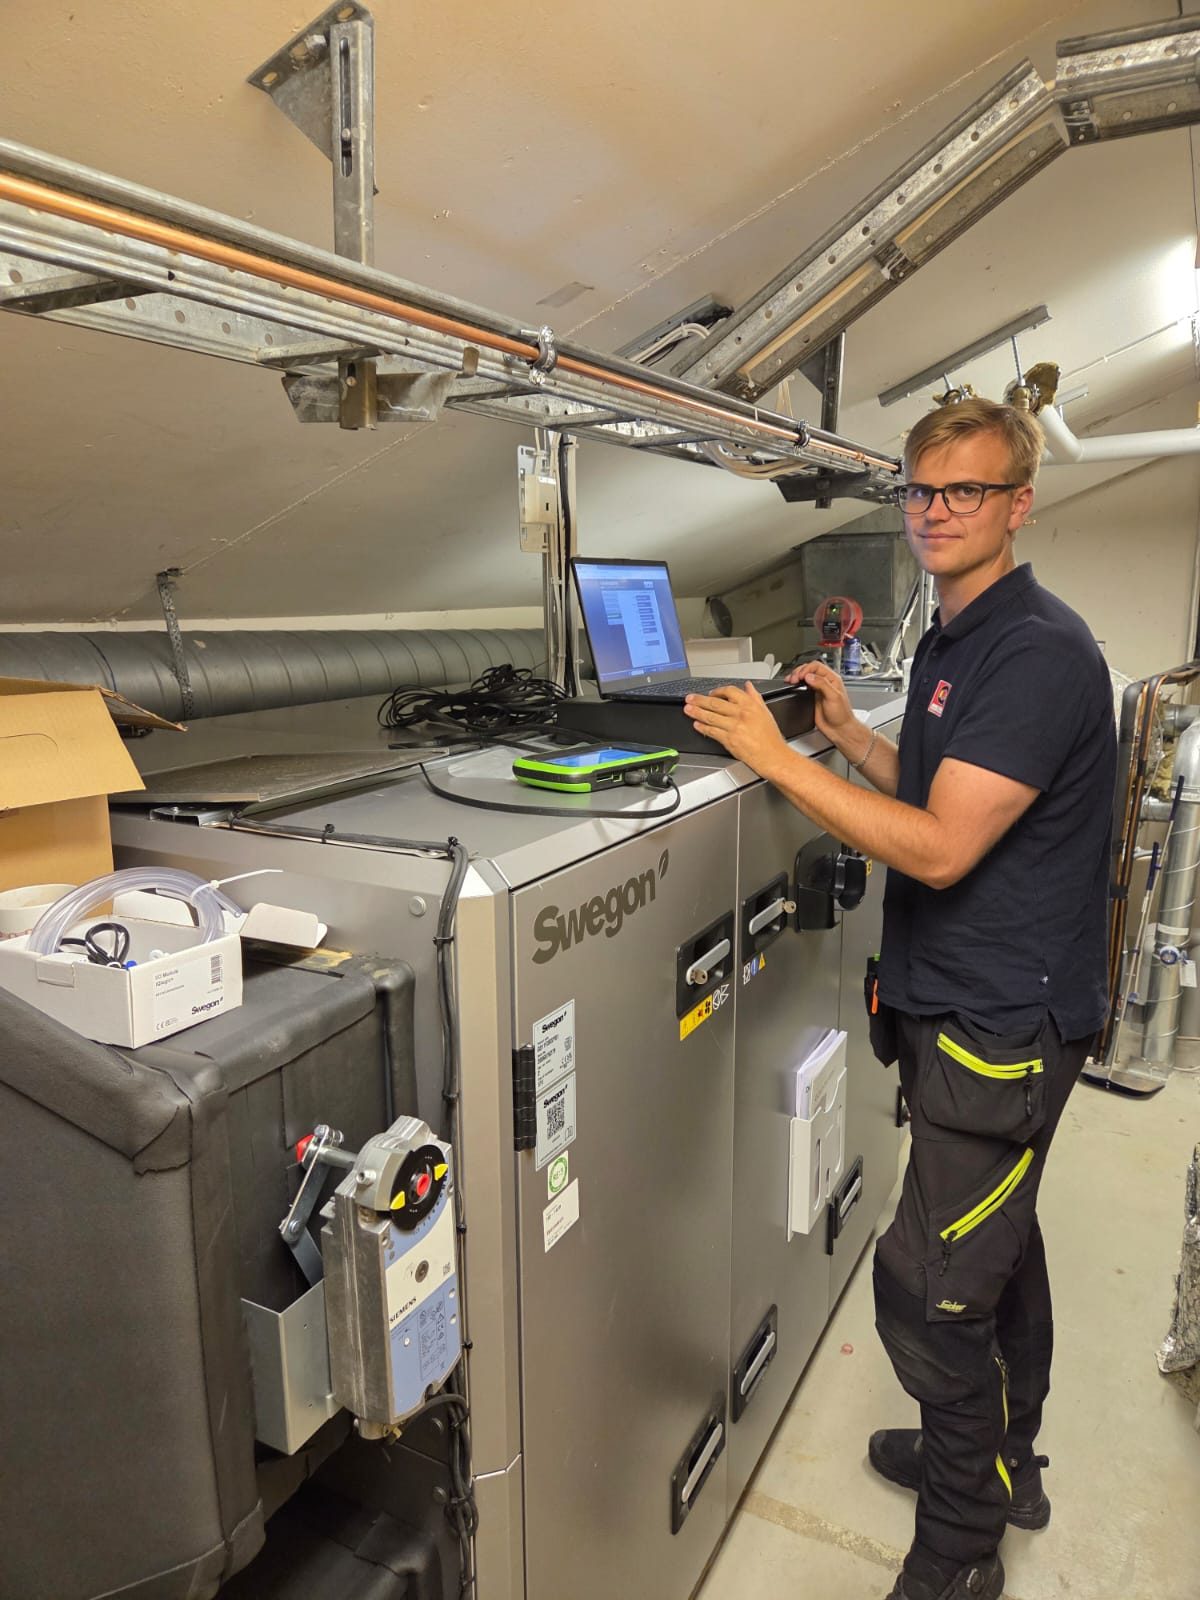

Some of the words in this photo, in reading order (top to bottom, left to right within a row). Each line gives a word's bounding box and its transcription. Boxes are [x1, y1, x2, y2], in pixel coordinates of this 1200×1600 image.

[532, 869, 655, 964] Swegon
[192, 1000, 219, 1014] Swegon
[542, 1015, 564, 1033] Swegon
[543, 1087, 566, 1109] Swegon
[390, 1297, 416, 1323] SIEMENS
